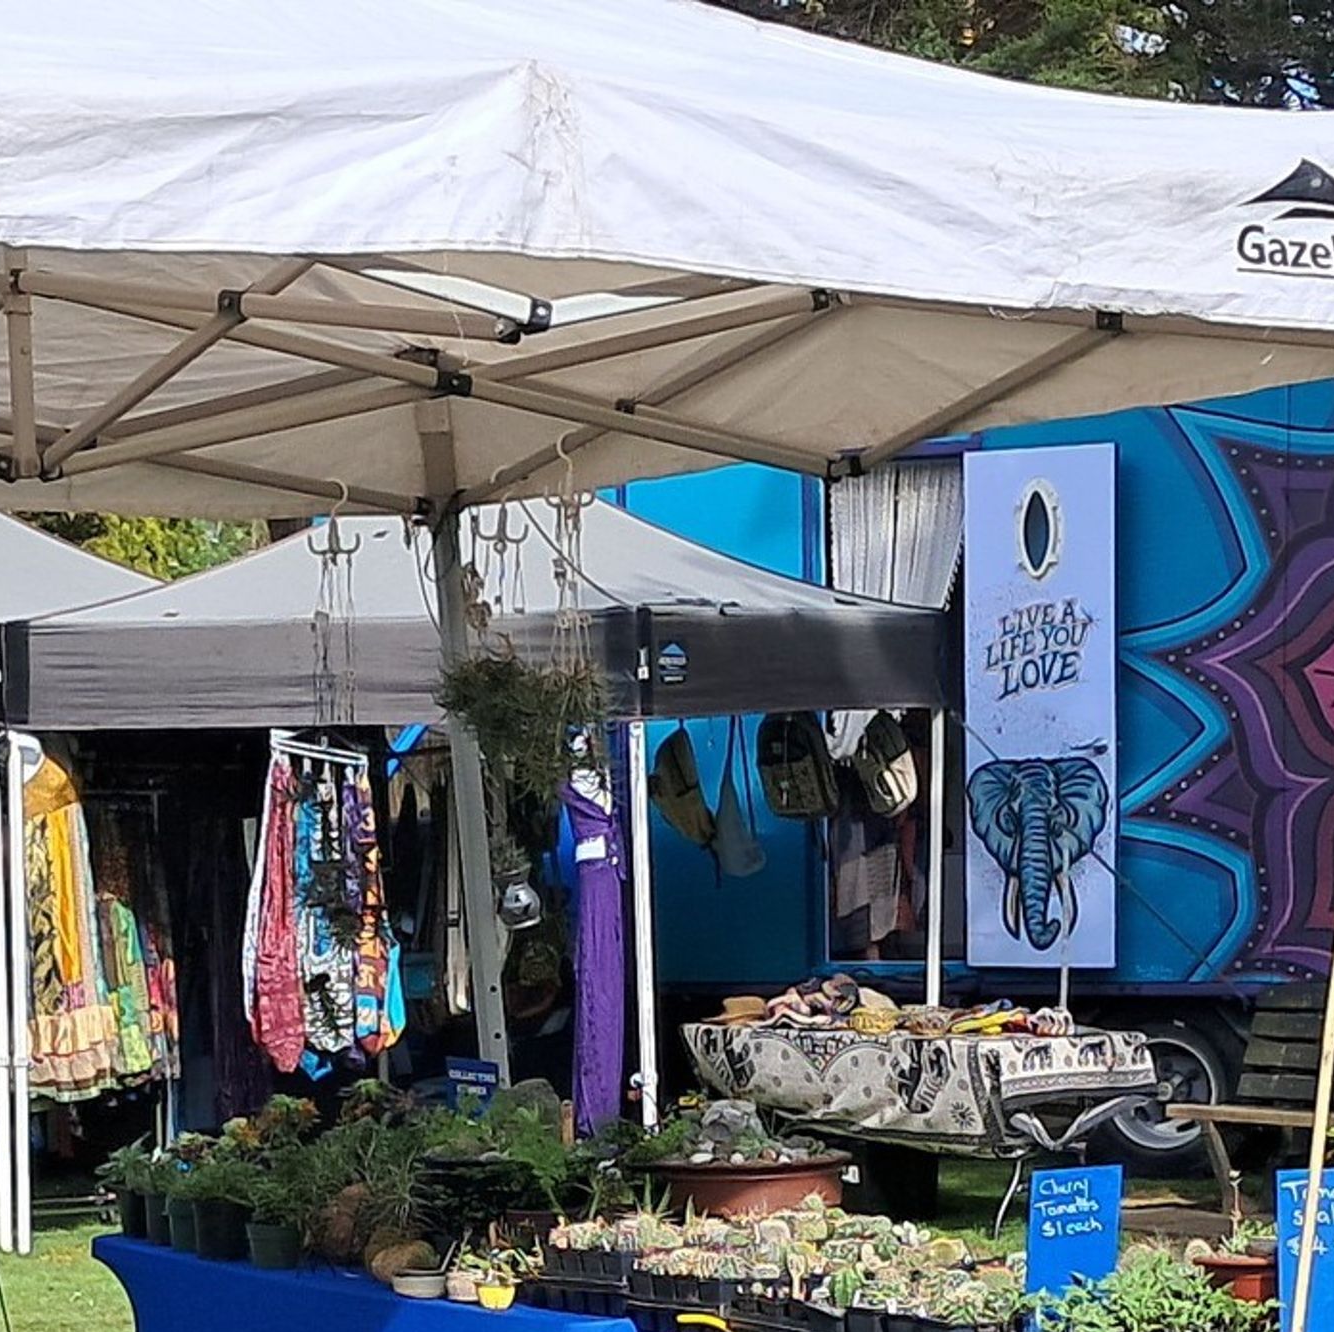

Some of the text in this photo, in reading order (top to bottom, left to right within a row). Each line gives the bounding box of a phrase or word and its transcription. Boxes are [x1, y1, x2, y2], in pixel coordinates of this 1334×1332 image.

[999, 600, 1077, 637] LIVE A
[986, 622, 1088, 670] LIFE YOU
[996, 650, 1081, 701] LOVE
[1066, 1215, 1103, 1235] each
